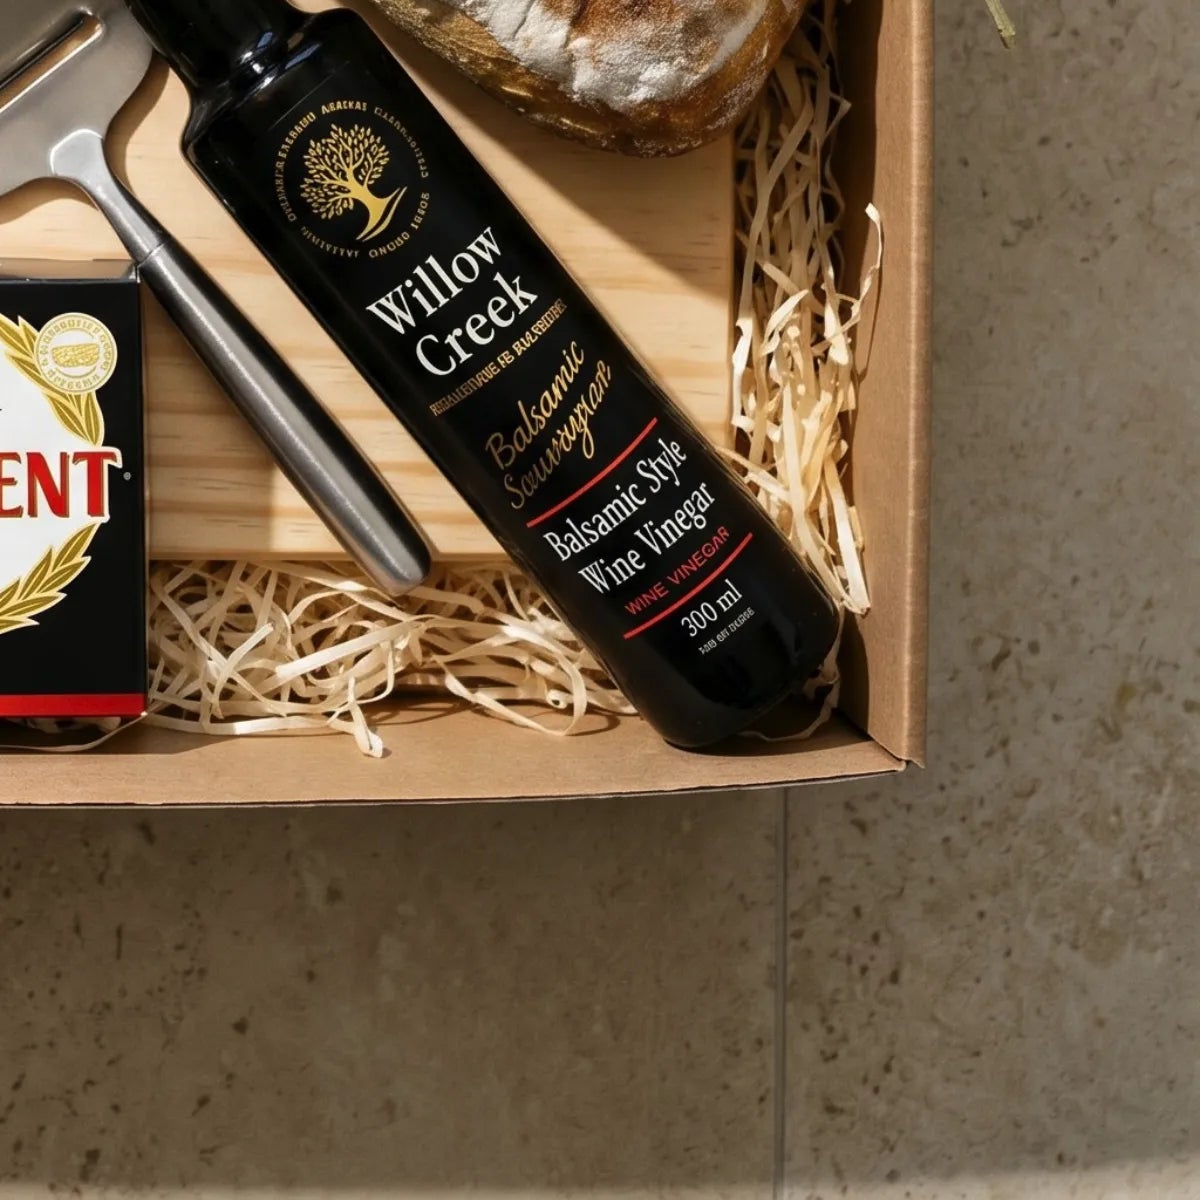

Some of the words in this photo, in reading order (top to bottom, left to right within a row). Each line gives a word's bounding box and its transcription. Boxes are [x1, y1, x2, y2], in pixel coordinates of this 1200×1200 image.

[365, 226, 502, 335] Willow
[415, 272, 538, 376] Creek
[484, 340, 585, 471] Balsamic
[543, 482, 647, 562] Balsamic
[636, 438, 687, 494] Style
[578, 548, 646, 594] Wine
[634, 482, 716, 557] Vinegar
[624, 586, 669, 616] WINE
[667, 526, 730, 586] VINEGAR
[681, 602, 719, 637] 300
[718, 578, 743, 608] ml
